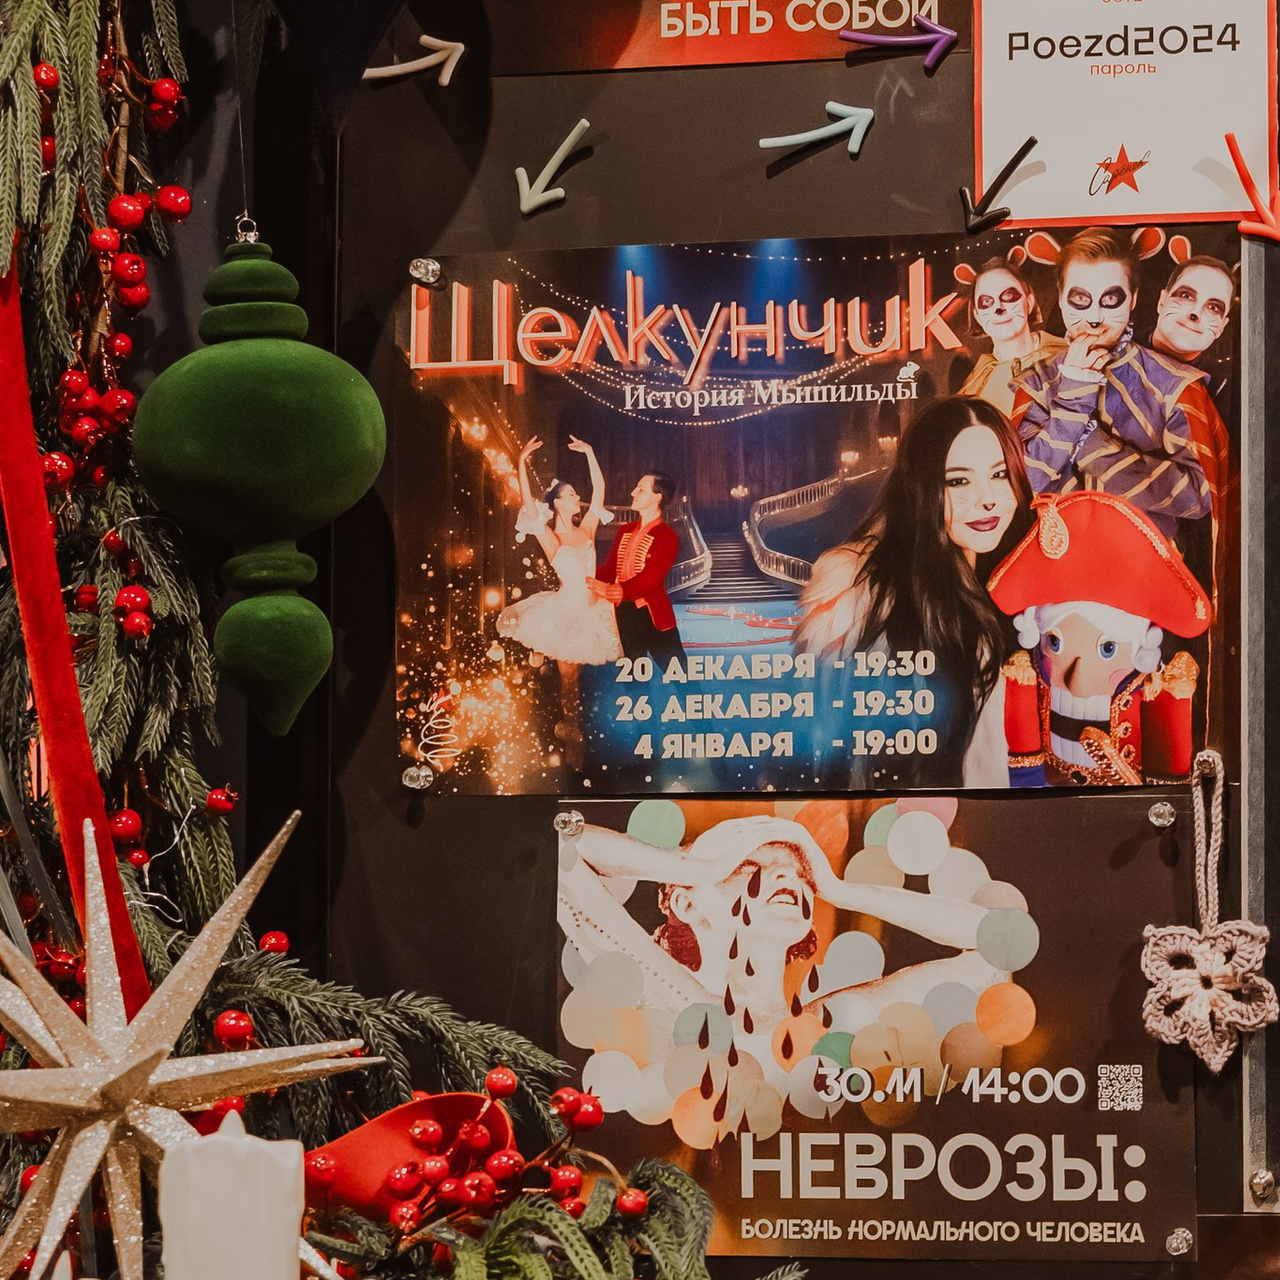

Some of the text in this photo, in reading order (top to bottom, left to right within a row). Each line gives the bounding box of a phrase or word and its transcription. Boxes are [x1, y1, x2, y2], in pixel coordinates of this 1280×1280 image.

[660, 0, 773, 39] БЫТЬ
[1007, 22, 1241, 61] Poezd2024
[1089, 61, 1157, 78] пароль
[409, 257, 963, 387] Щелкунчик
[623, 380, 918, 415] История Мышильды
[614, 657, 654, 683] 20
[662, 653, 815, 684] ДЕКАБРЯ
[853, 650, 937, 678] 19:30
[614, 695, 653, 721] 26
[661, 692, 814, 722] ДЕКАБРЯ
[852, 689, 936, 717] 19:30
[633, 734, 654, 759] 4
[661, 731, 794, 759] ЯНВАРЯ
[852, 728, 938, 756] 19:00
[817, 1066, 922, 1103] 30.11
[961, 1066, 1086, 1104] 14:00
[740, 1132, 1147, 1203] НЕВРОЗЫ:
[741, 1218, 1146, 1243] БОЛЕЗНЬ НОРМАЛЬНОГО ЧЕЛОВЕКА
